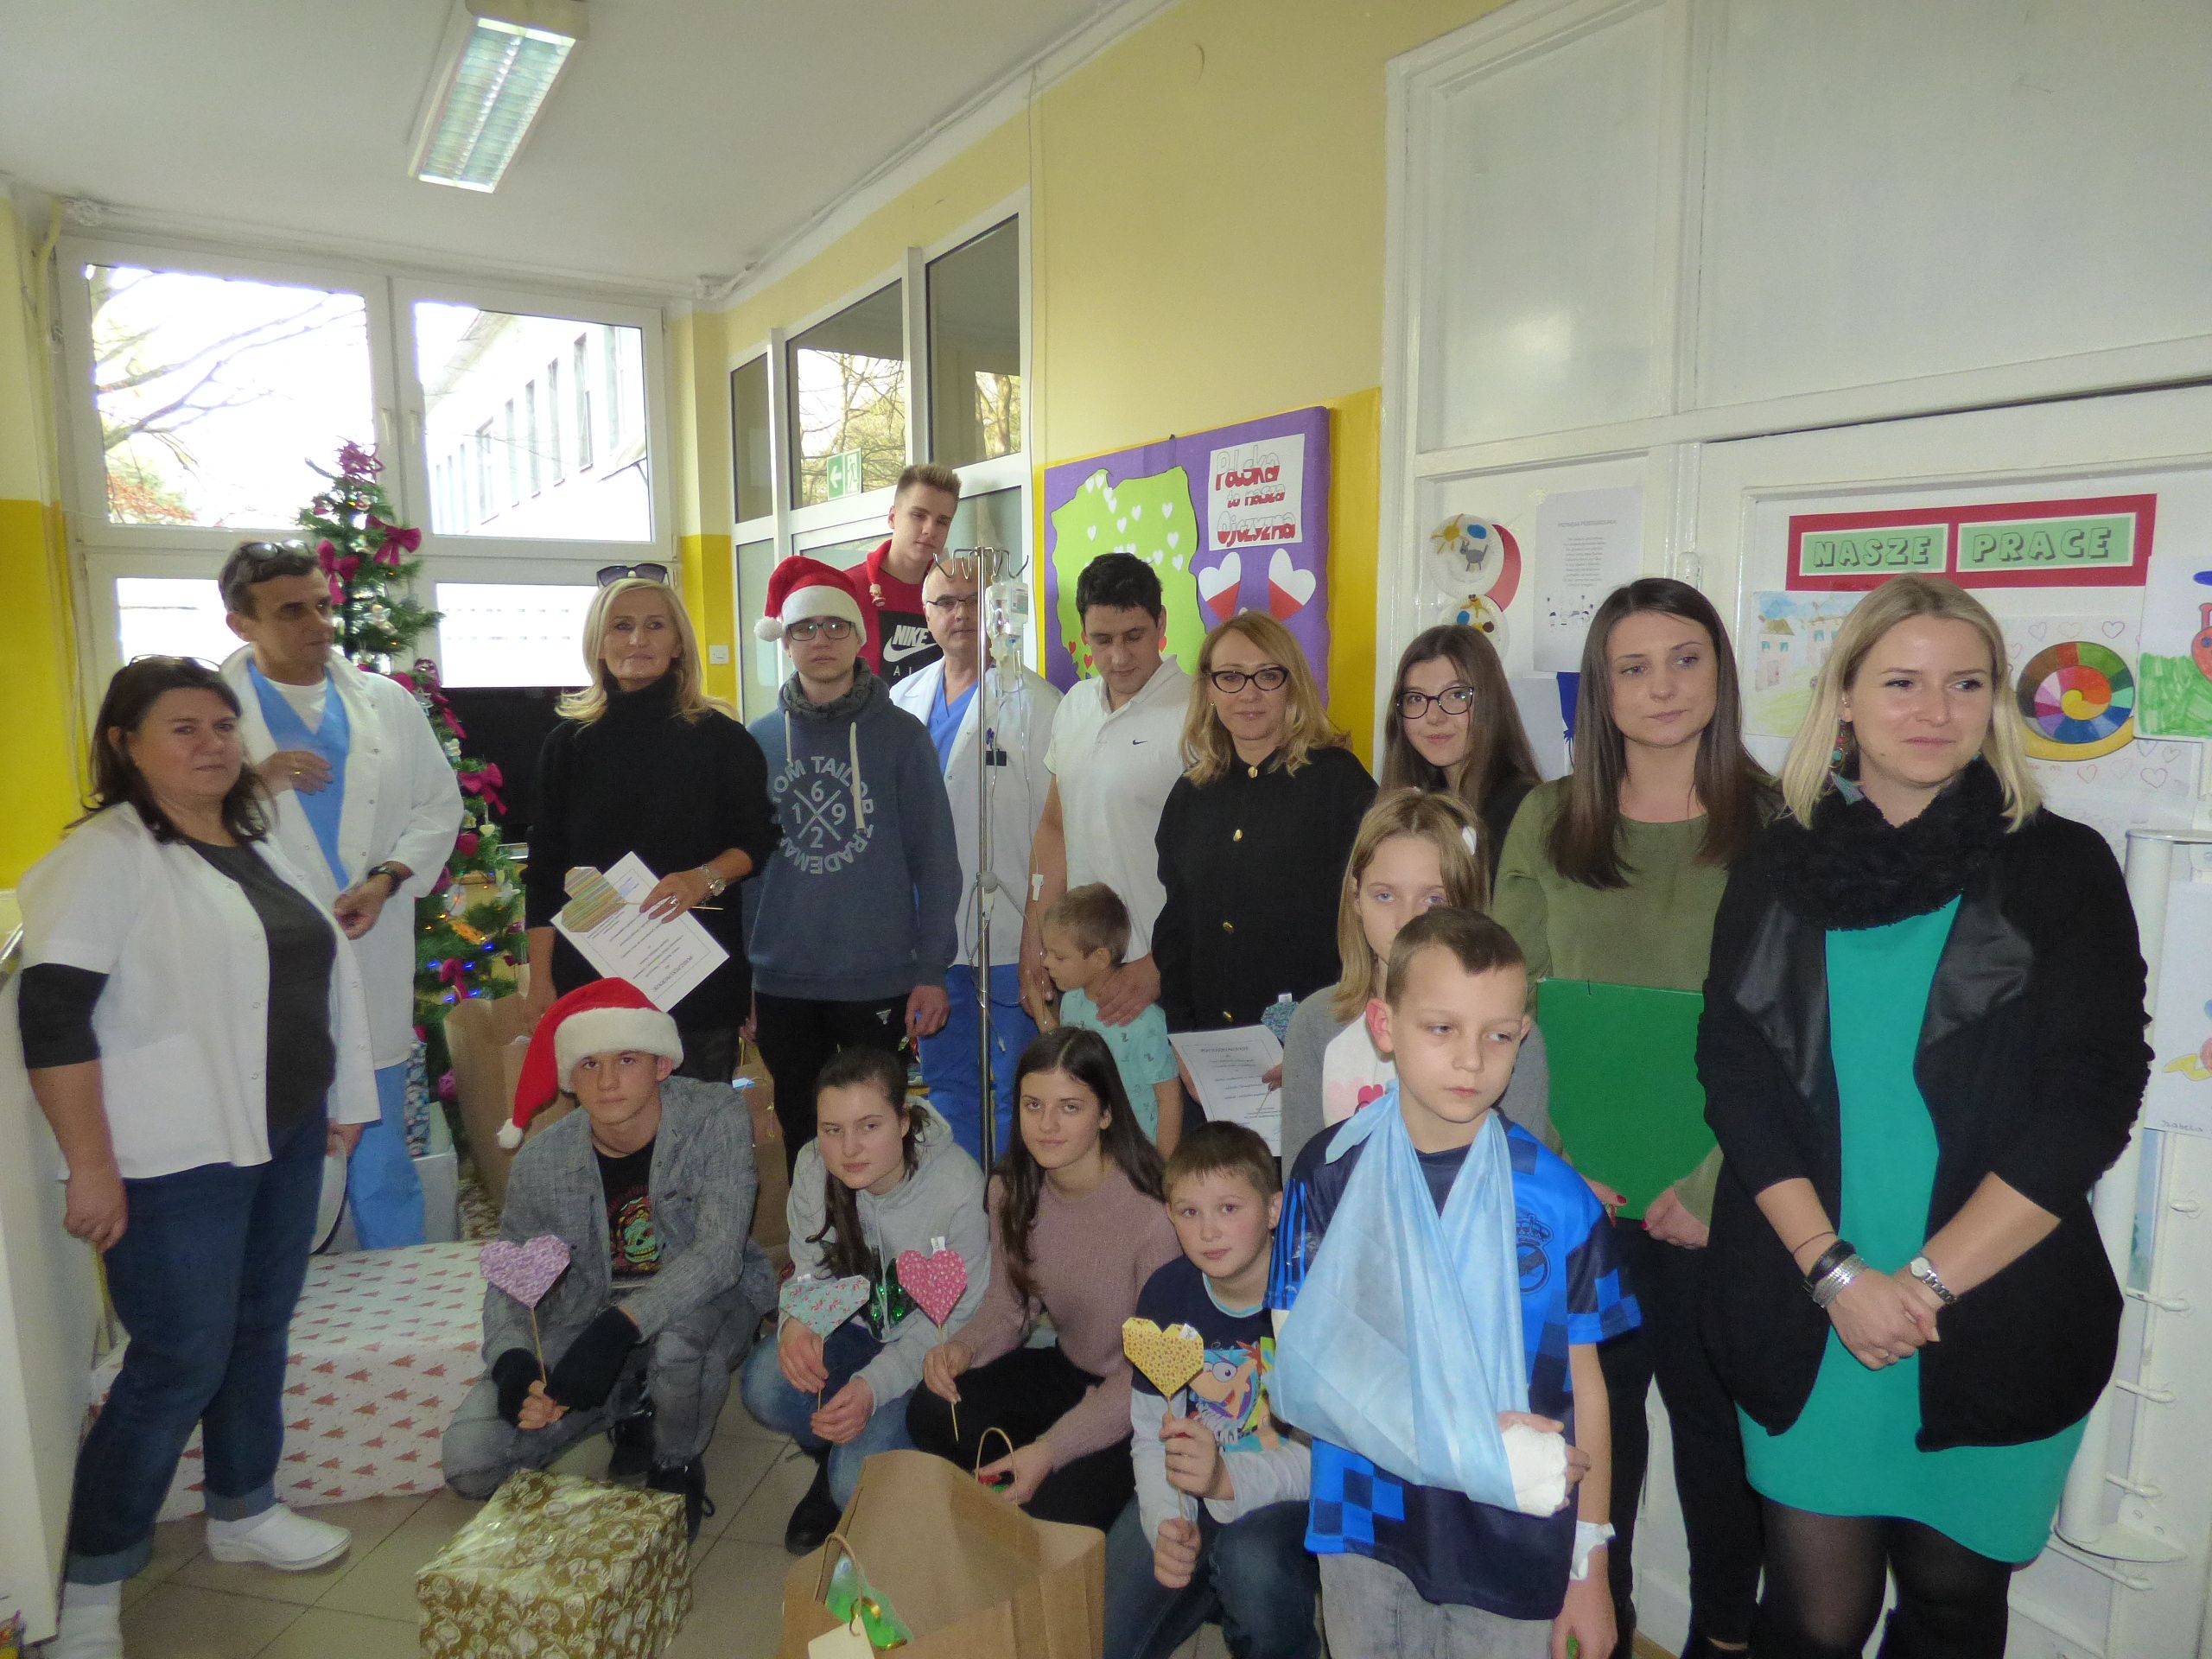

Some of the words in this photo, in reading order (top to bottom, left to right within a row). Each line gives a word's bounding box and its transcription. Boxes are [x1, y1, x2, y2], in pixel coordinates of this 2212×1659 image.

[1215, 444, 1281, 491] Polska
[1226, 490, 1241, 509] to
[1244, 483, 1286, 506] nasza
[1217, 511, 1296, 547] Ojczyzna
[1814, 537, 1932, 567] NASZE
[1972, 526, 2113, 563] PRACE
[891, 624, 930, 647] NIKE
[810, 780, 824, 802] 6
[791, 803, 802, 824] 1
[831, 804, 847, 826] 9
[810, 826, 823, 849] 2
